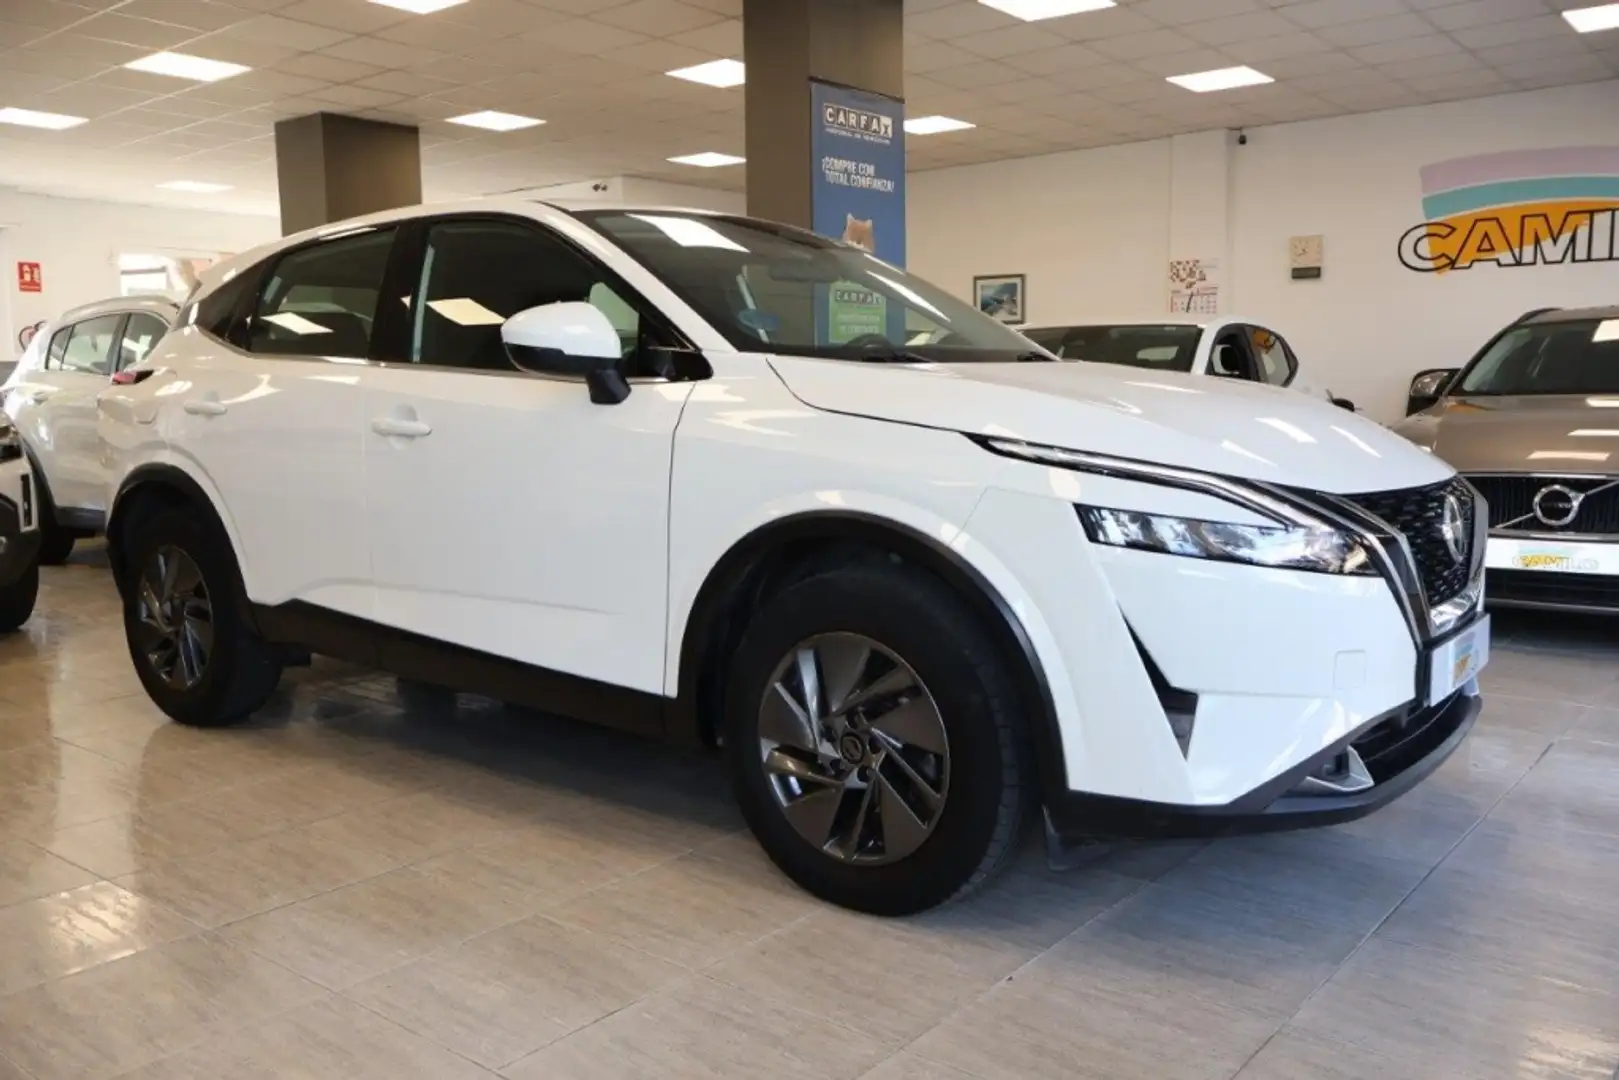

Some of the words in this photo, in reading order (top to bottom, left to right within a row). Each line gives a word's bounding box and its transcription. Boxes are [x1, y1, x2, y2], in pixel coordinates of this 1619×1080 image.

[824, 104, 892, 138] CARFAX
[825, 170, 849, 186] TOTAL
[858, 162, 876, 176] CON
[1397, 207, 1619, 273] CAMI
